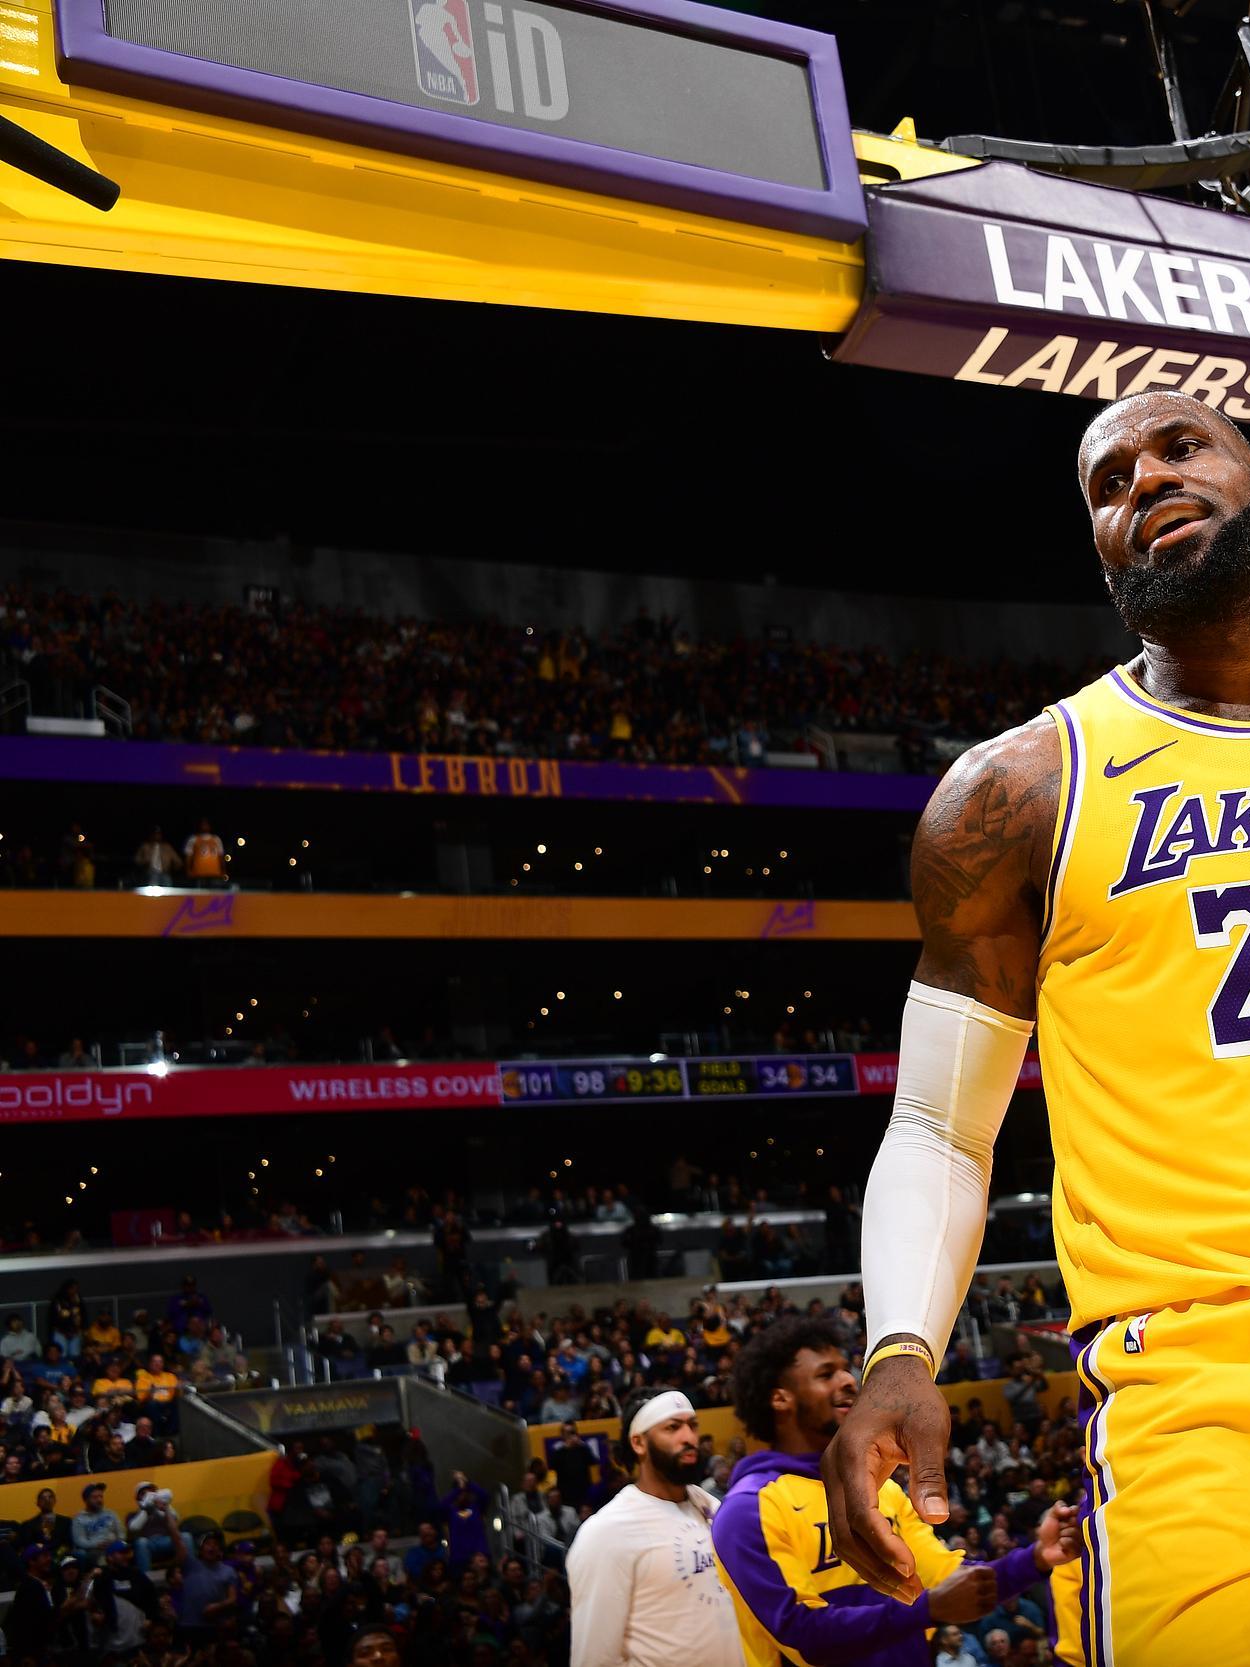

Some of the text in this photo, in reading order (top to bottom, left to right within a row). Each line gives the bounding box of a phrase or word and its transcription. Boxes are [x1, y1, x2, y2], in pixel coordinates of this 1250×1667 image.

[389, 752, 563, 798] LEBRON
[699, 1062, 741, 1077] FIELD
[762, 1066, 789, 1088] 34
[811, 1064, 839, 1086] 34
[288, 1077, 429, 1102] WIRELESS
[518, 1072, 553, 1093] 101
[573, 1070, 606, 1095] 98
[626, 1069, 682, 1093] 9:36
[698, 1079, 747, 1094] GOALS
